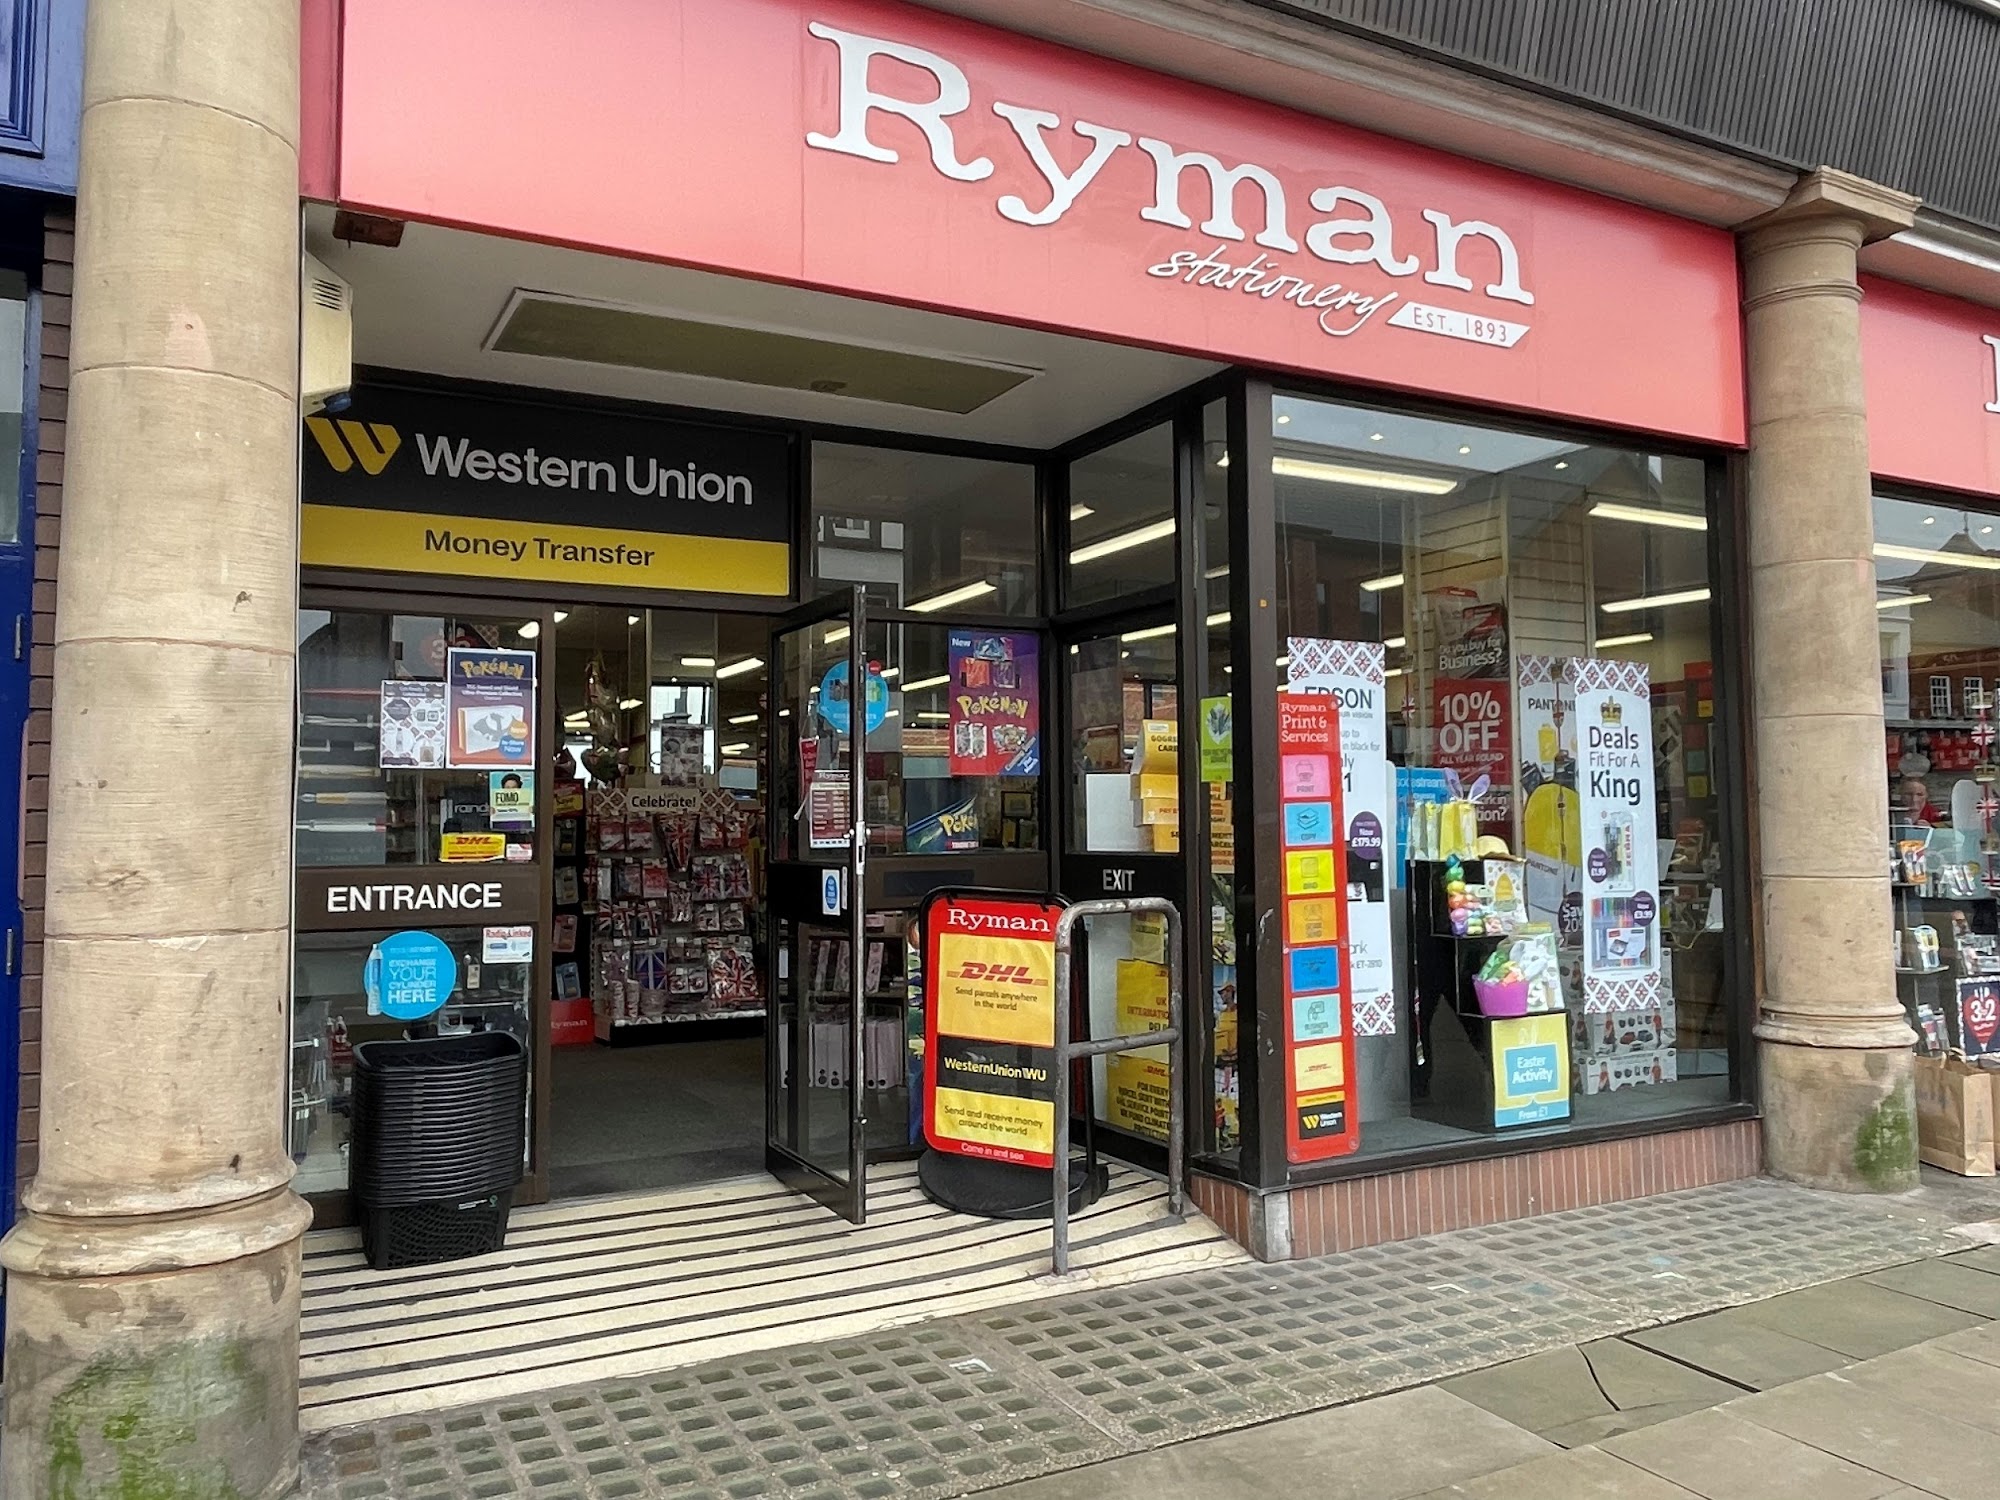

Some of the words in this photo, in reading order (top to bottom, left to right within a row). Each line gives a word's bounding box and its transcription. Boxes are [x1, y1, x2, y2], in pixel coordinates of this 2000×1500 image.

[806, 21, 1535, 305] Ryman
[1147, 244, 1400, 337] stationery
[1412, 306, 1455, 332] EST.
[1463, 316, 1508, 343] 1893
[415, 433, 618, 493] Western
[625, 455, 753, 506] Union
[424, 528, 527, 562] Money
[532, 536, 656, 567] Transfer
[951, 636, 972, 648] New
[1469, 639, 1486, 652] buy
[1487, 636, 1502, 648] for
[1439, 647, 1502, 671] Business?
[459, 658, 526, 680] Pokémon
[957, 692, 1029, 719] Pokémon
[1281, 702, 1327, 714] Ryman
[1439, 689, 1500, 723] 10%
[1281, 714, 1317, 729] Print
[1318, 716, 1328, 728] &
[1281, 730, 1329, 743] Services
[1439, 719, 1500, 755] OFF
[1588, 725, 1640, 750] Deals
[1440, 755, 1454, 765] ALL
[1475, 752, 1505, 763] ROUND
[1589, 751, 1605, 767] Fit
[1607, 752, 1627, 768] For
[1630, 752, 1640, 768] A
[1296, 785, 1315, 793] PRINT
[1589, 770, 1641, 806] King
[631, 795, 696, 809] Celebrate!
[455, 836, 491, 845] DHL
[1359, 828, 1374, 836] Now
[1351, 837, 1381, 848] £179.99
[1102, 868, 1136, 892] EXIT
[327, 881, 503, 914] ENTRANCE
[1562, 902, 1583, 919] Sav
[947, 908, 1051, 933] Ryman
[388, 966, 437, 982] YOUR
[958, 961, 1037, 985] DHL
[387, 989, 437, 1005] HERE
[955, 986, 973, 998] Send
[974, 988, 1000, 1001] parcels
[1000, 990, 1038, 1004] anywhere
[981, 1000, 994, 1009] the
[996, 1001, 1018, 1012] world
[1970, 1000, 1981, 1023] 3
[1984, 998, 1997, 1021] 2
[944, 1056, 1022, 1080] WesternUnion
[1517, 1055, 1547, 1069] Easter
[1512, 1067, 1553, 1085] Activity
[944, 1105, 965, 1117] Send
[966, 1107, 982, 1120] and
[984, 1110, 1013, 1124] receive
[1014, 1115, 1044, 1130] money
[1518, 1110, 1538, 1120] From
[958, 1118, 988, 1130] around
[989, 1120, 1004, 1133] the
[1006, 1123, 1028, 1136] world
[960, 1142, 984, 1155] Come
[984, 1146, 992, 1156] in
[993, 1148, 1008, 1158] and
[1009, 1151, 1025, 1162] see
